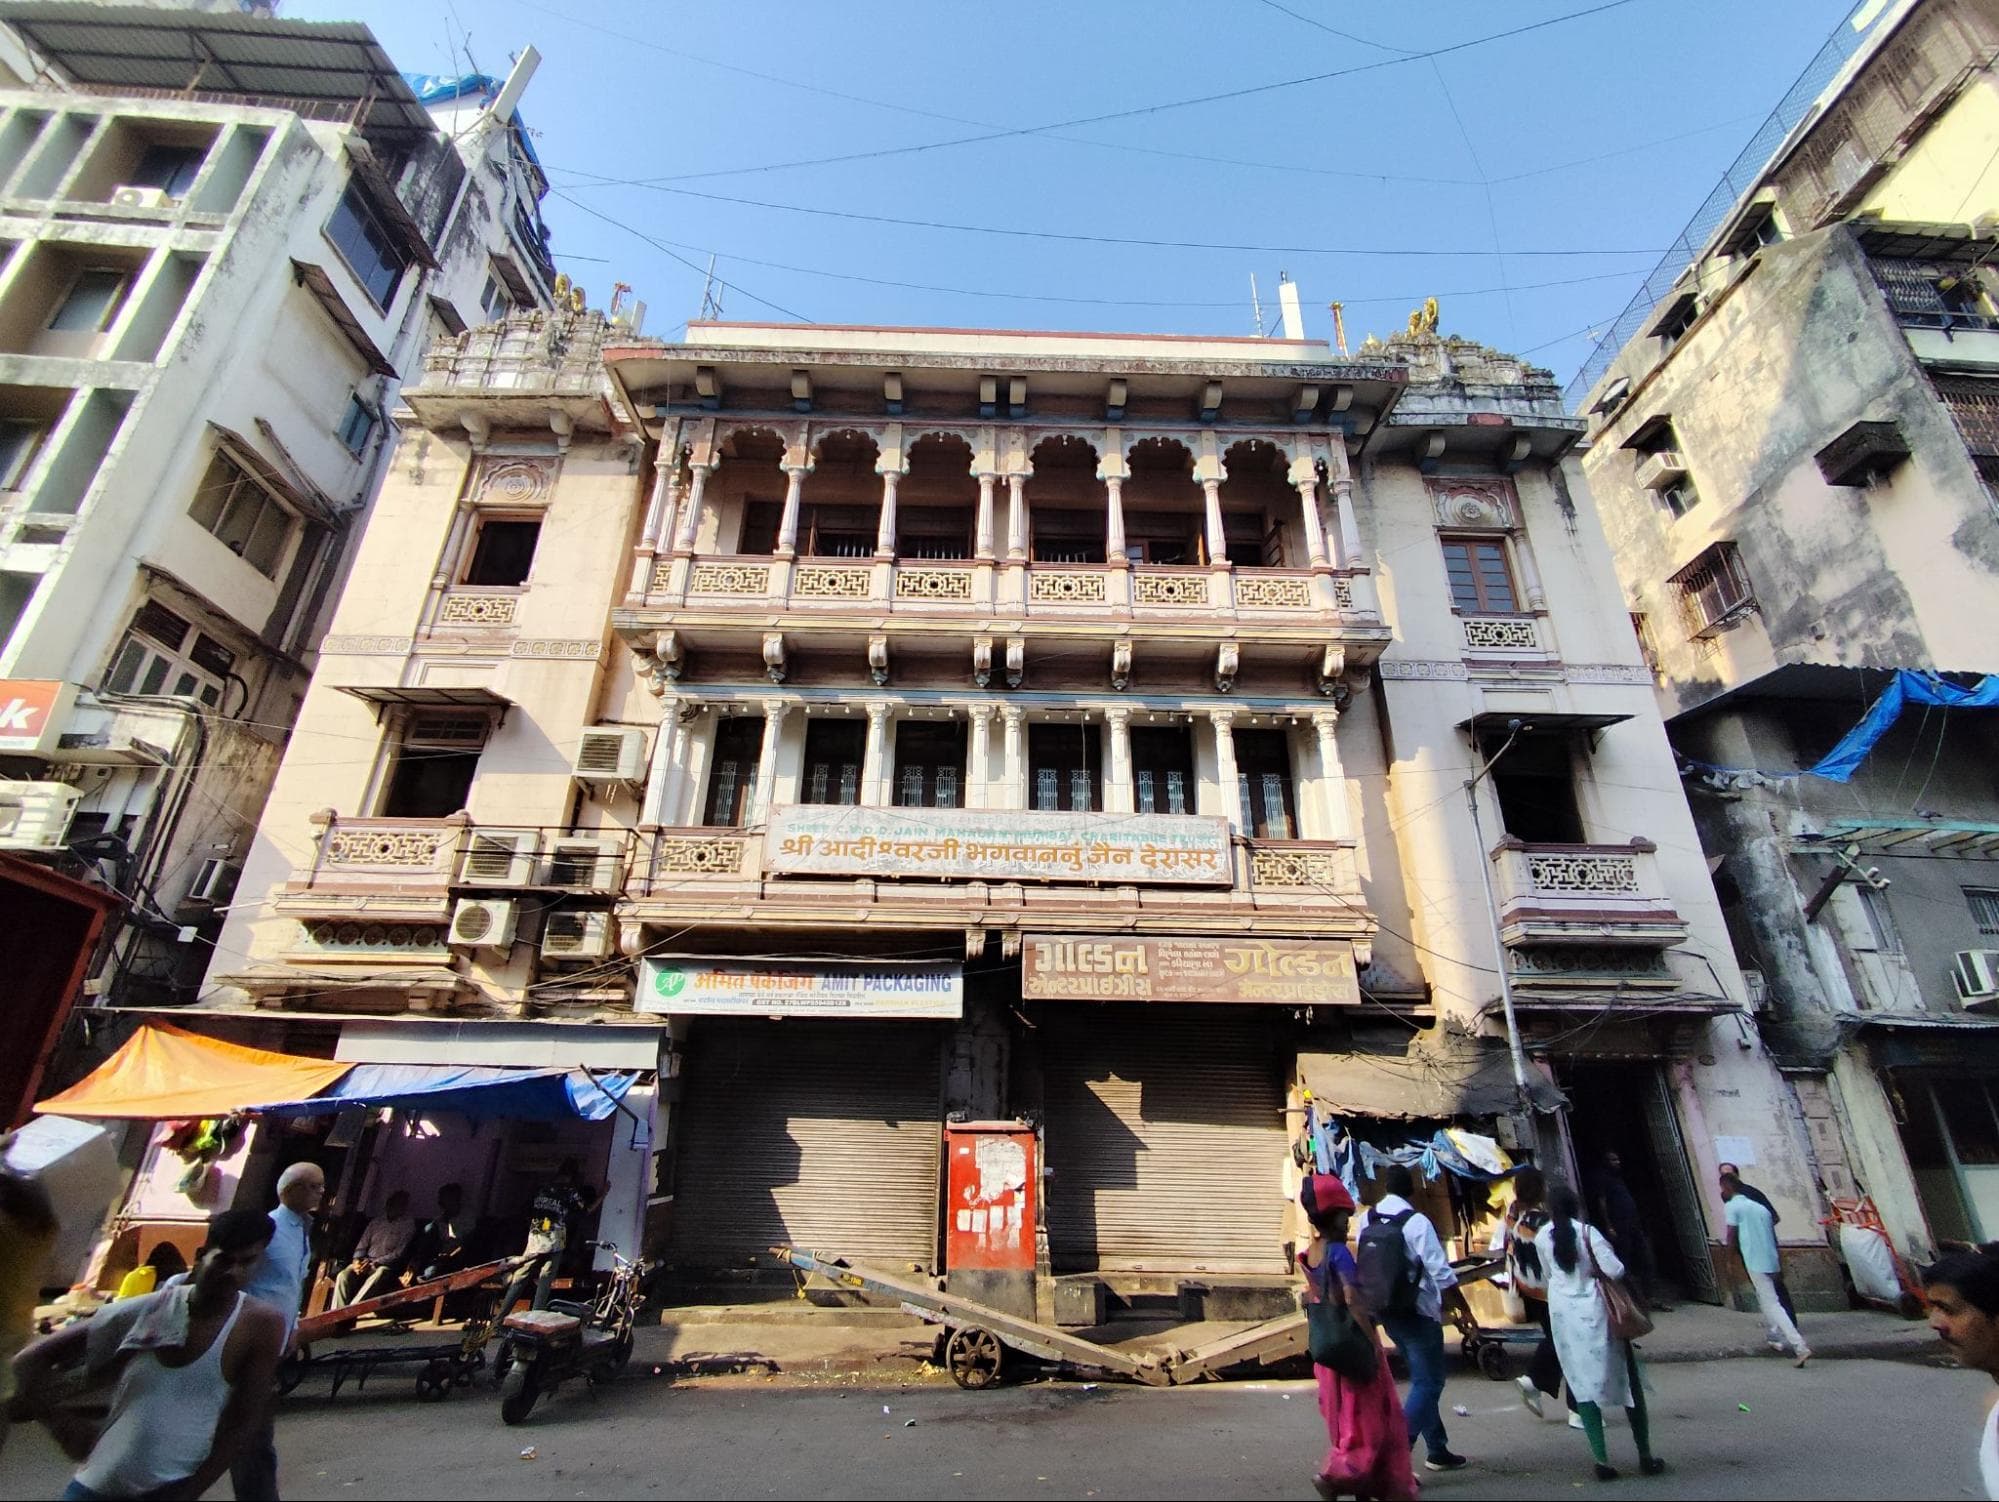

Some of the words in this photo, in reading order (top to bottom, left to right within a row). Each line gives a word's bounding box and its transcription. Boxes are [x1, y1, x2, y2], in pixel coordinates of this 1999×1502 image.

[894, 826, 929, 837] JAIN
[779, 834, 814, 857] श्री
[819, 836, 961, 862] आदीश्वरजी
[1087, 841, 1134, 865] जैन
[1139, 843, 1221, 870] देरासर
[694, 967, 748, 990] अमित
[821, 972, 861, 991] AMIT
[864, 973, 952, 992] PACKAGING
